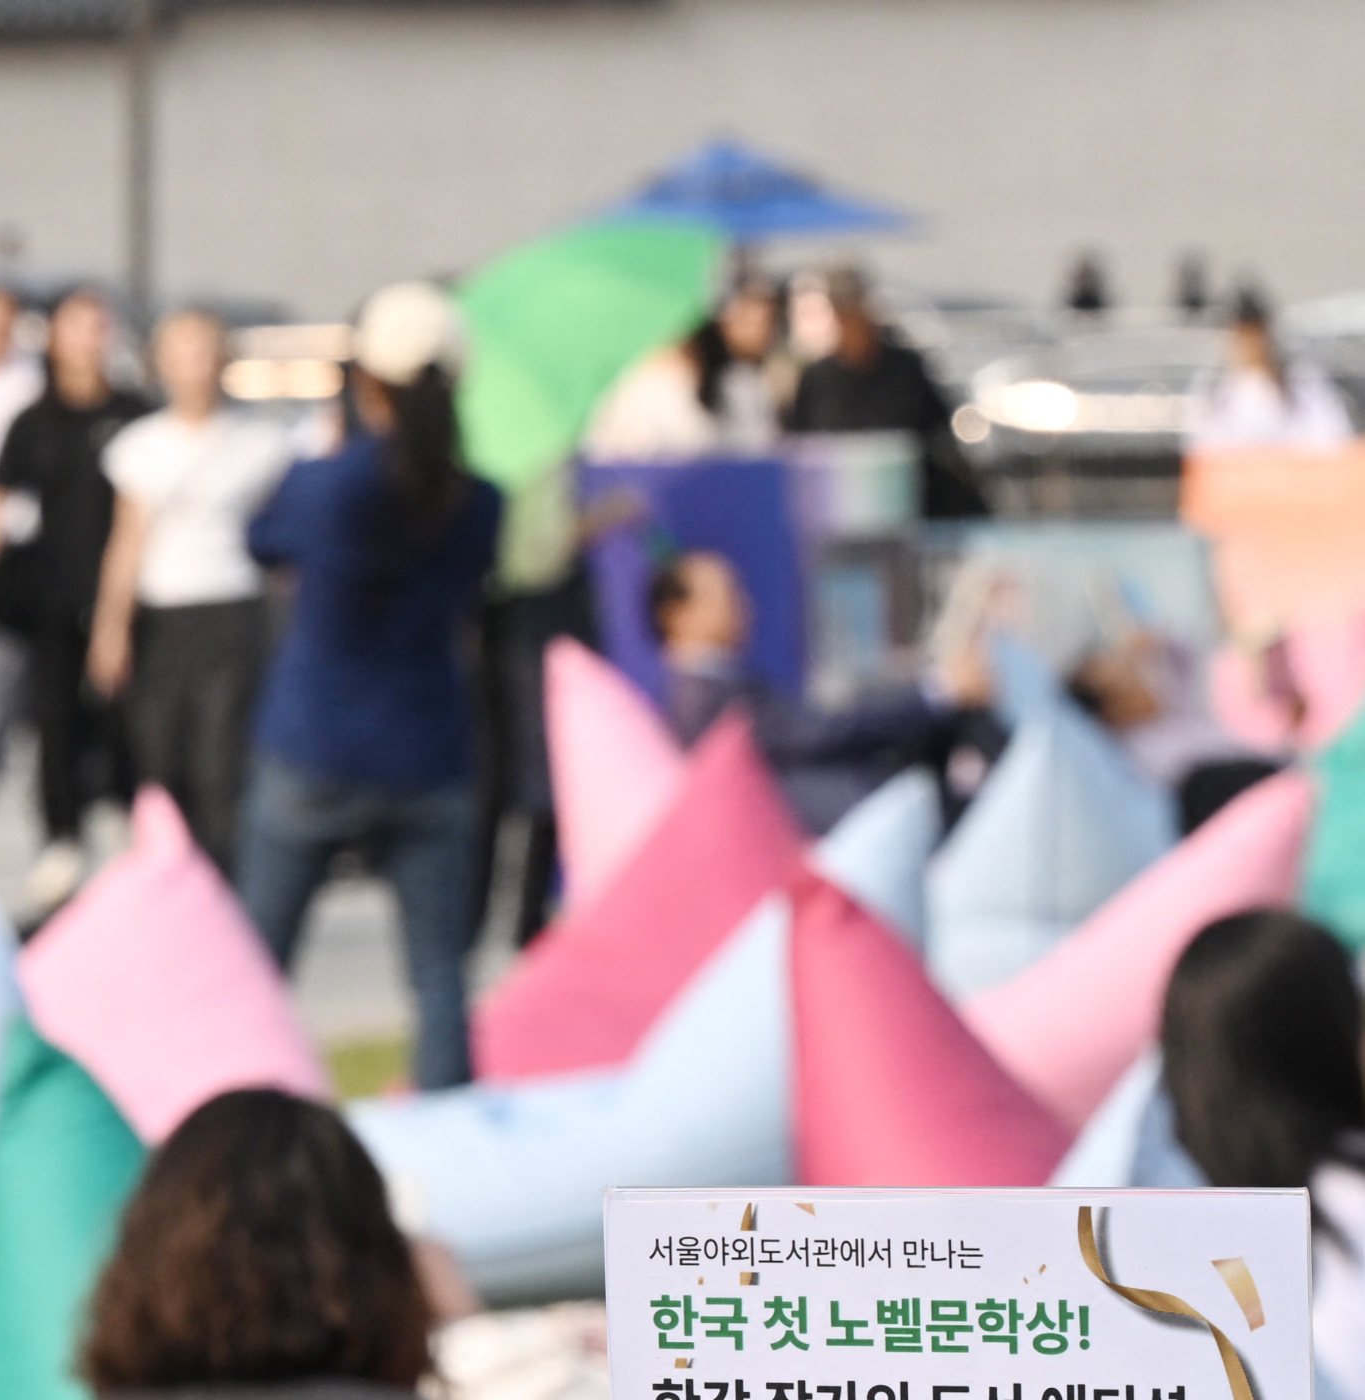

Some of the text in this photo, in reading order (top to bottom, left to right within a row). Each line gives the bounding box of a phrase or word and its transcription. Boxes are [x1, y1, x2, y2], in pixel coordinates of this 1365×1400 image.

[649, 1235, 984, 1269] 서울야외도서관에서 만나는
[650, 1294, 1090, 1355] 한국 첫 노벨문학상!
